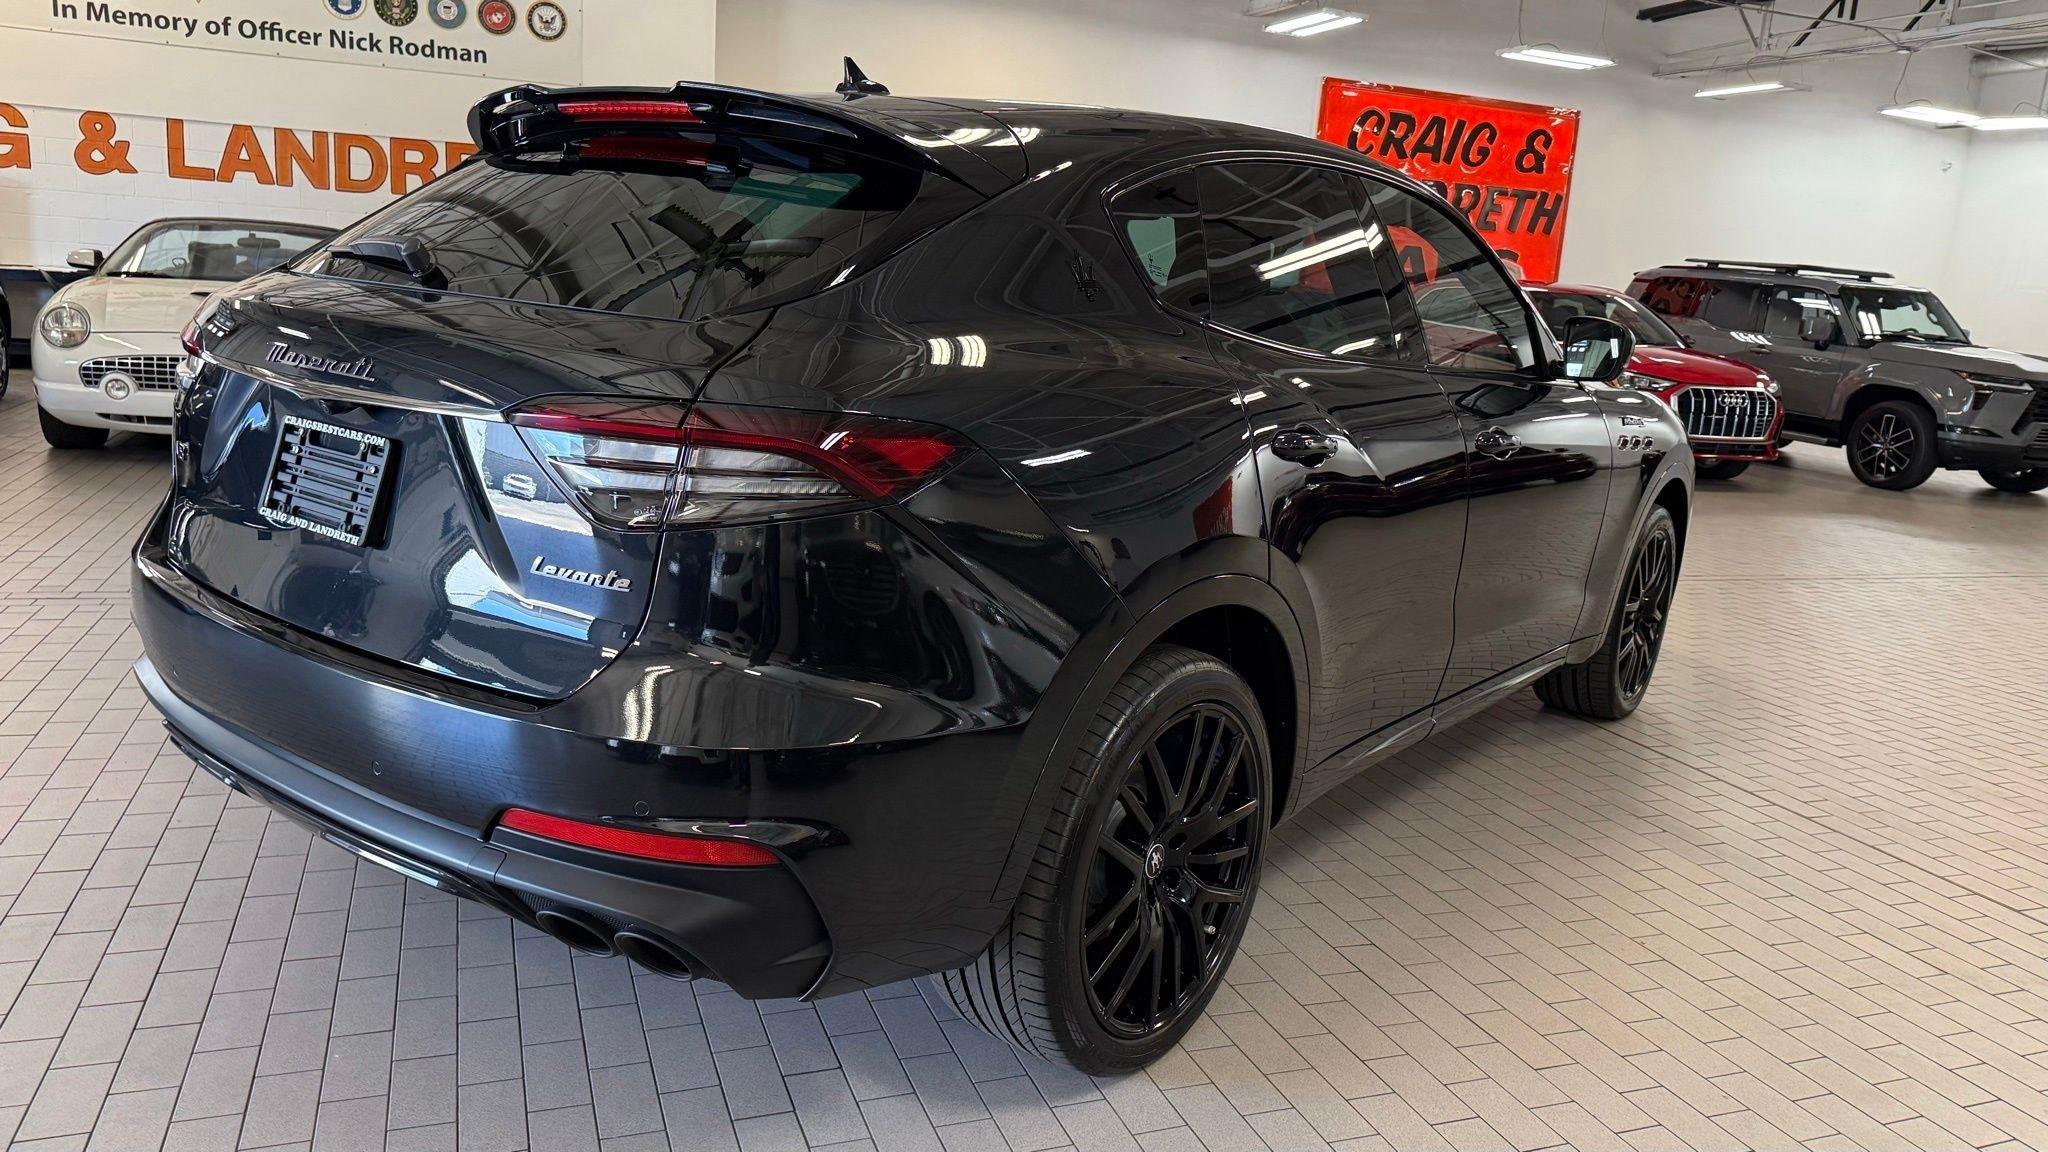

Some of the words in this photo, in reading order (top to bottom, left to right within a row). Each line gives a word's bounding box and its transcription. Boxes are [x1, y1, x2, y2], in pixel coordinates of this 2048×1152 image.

[52, 0, 77, 19] In
[86, 1, 198, 38] Memory
[205, 16, 232, 36] of
[238, 19, 322, 46] Officer
[329, 29, 383, 53] Nick
[389, 36, 488, 63] Rodman
[74, 110, 138, 175] &
[1347, 107, 1498, 168] CRAIG
[1514, 128, 1553, 175] &
[266, 342, 377, 383] Maserati
[284, 415, 386, 447] CRAIGSBESTCARS.COM
[259, 506, 287, 521] CRAIG
[287, 515, 308, 529] AND
[308, 521, 360, 546] LANDRETH
[530, 556, 632, 592] Levante
